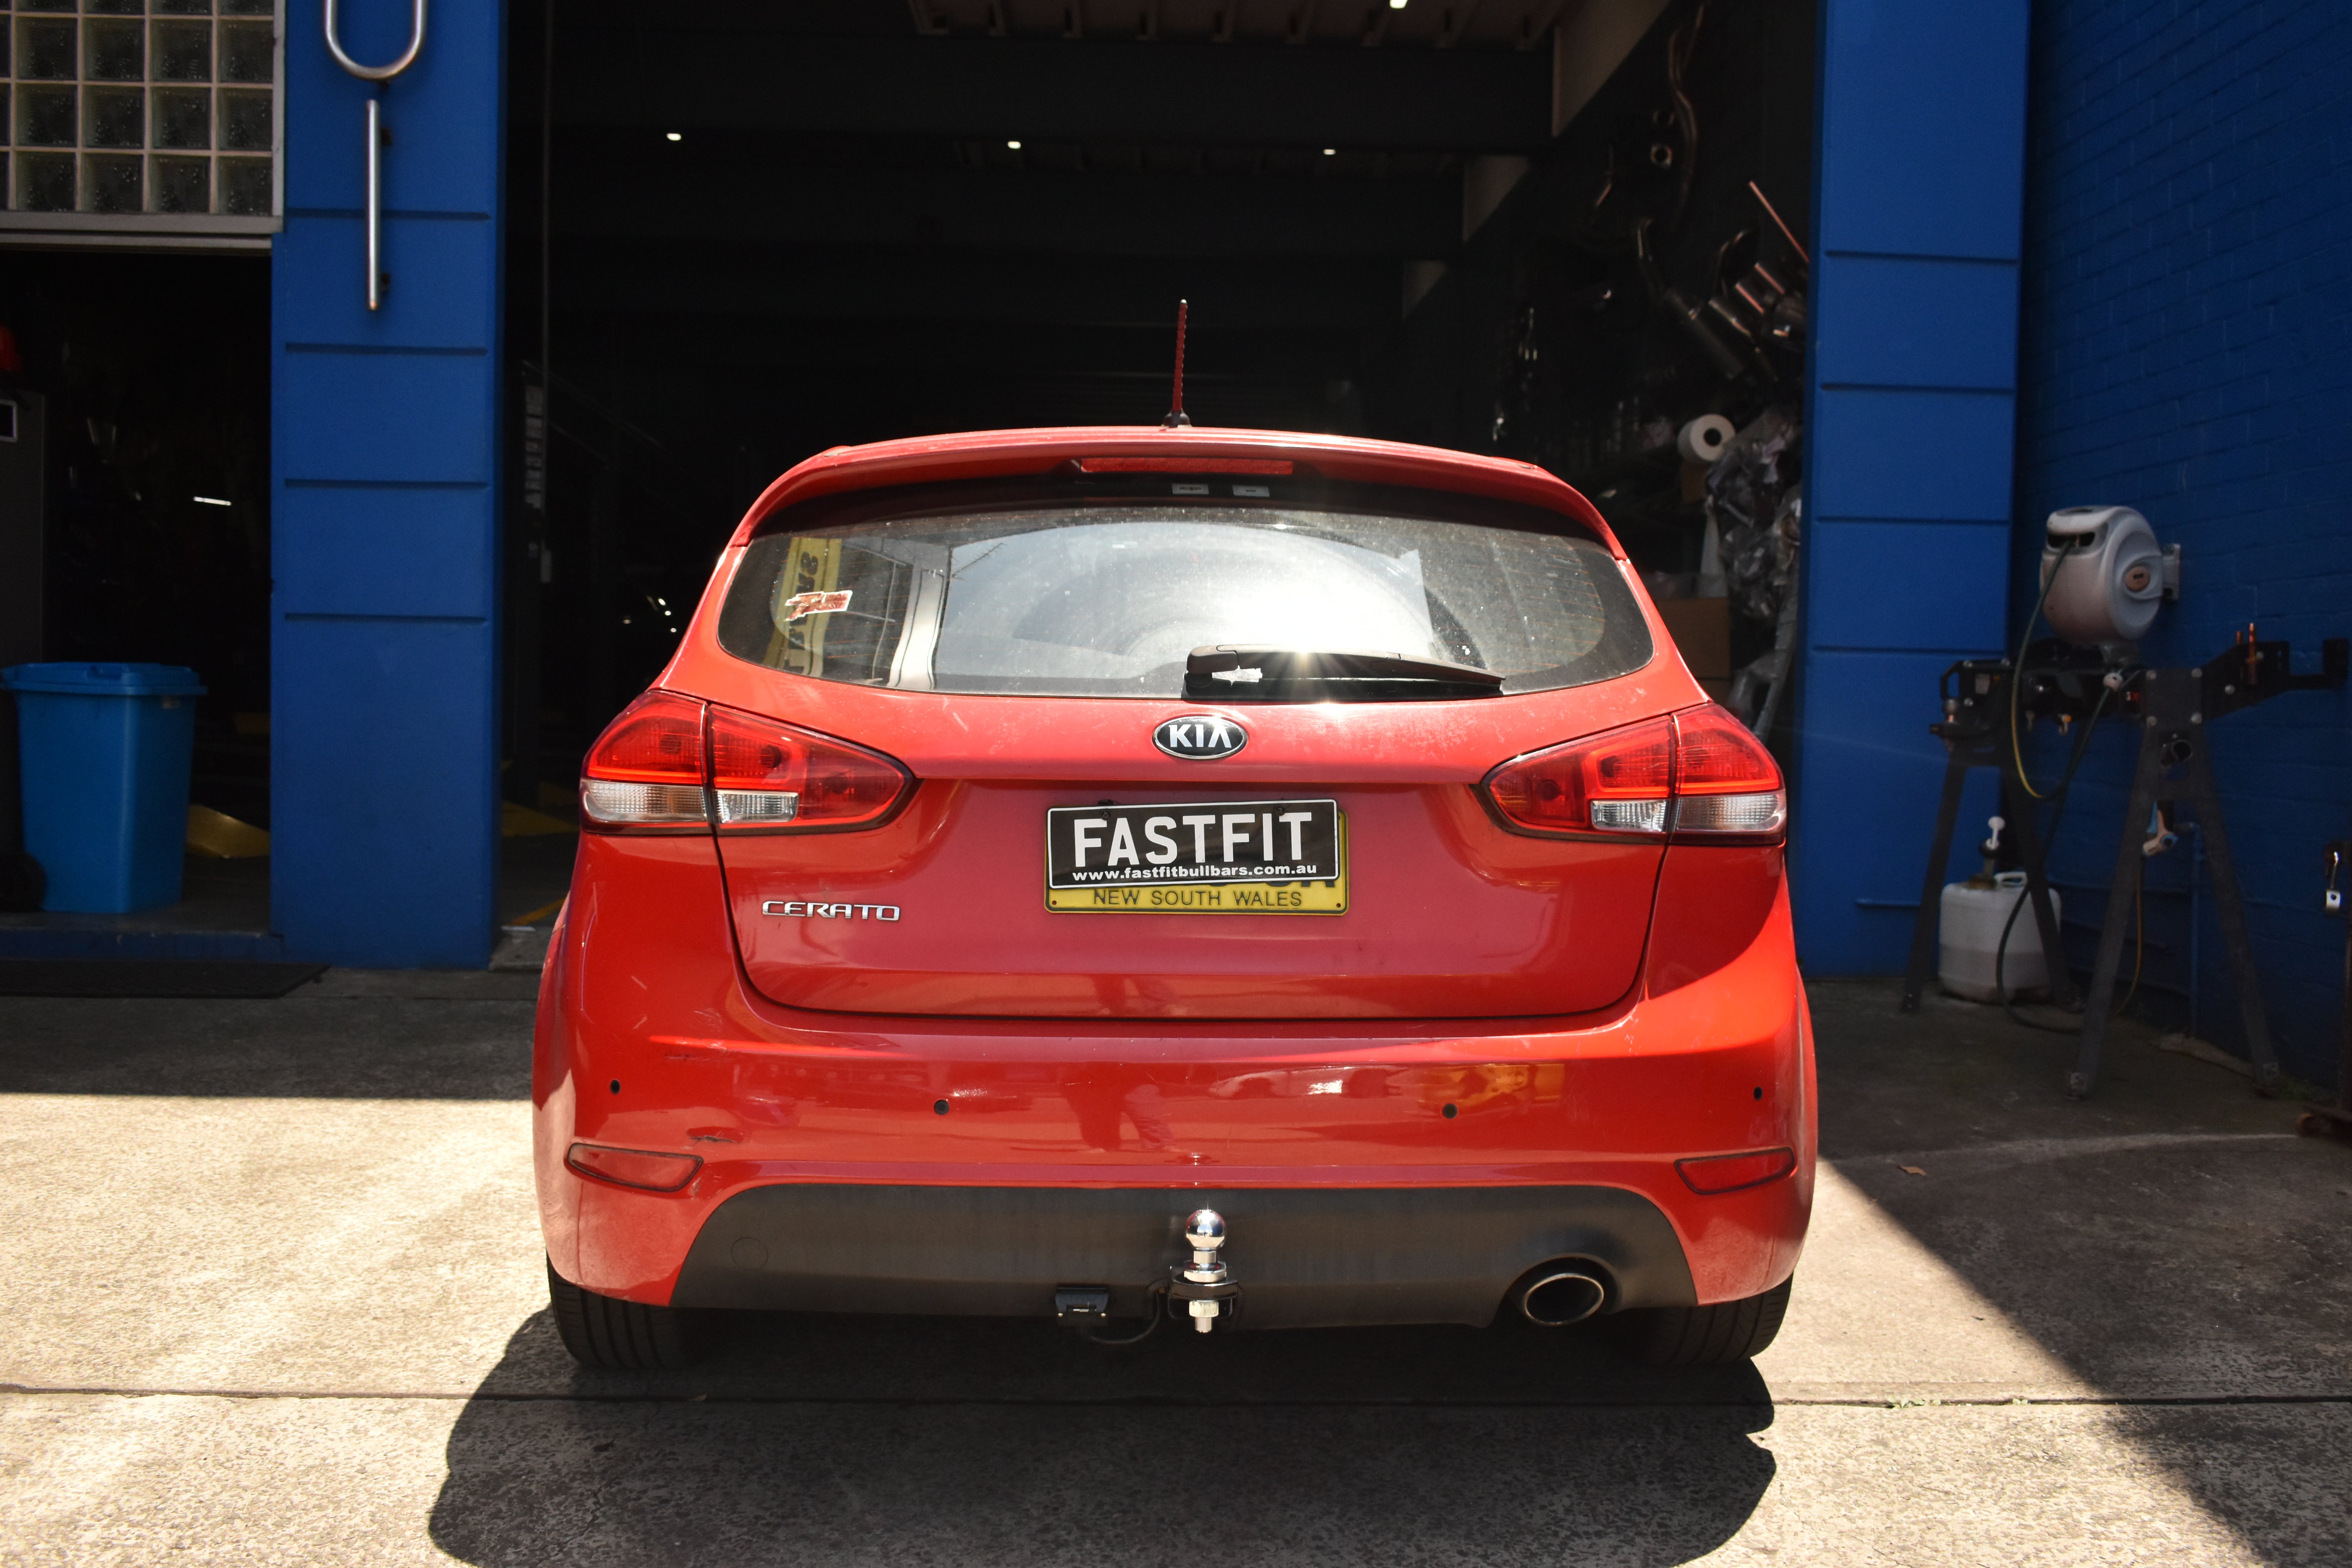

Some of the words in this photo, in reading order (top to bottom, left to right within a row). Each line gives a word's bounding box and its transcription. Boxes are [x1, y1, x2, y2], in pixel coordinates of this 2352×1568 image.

[1169, 724, 1232, 748] KIA
[1074, 812, 1312, 867] FASTFIT
[1072, 864, 1317, 881] www.fastfitbullbars.com.au
[1094, 890, 1140, 905] NEW
[1151, 891, 1220, 906] SOUTH
[1233, 891, 1301, 906] WALES
[762, 901, 900, 921] CERATO
